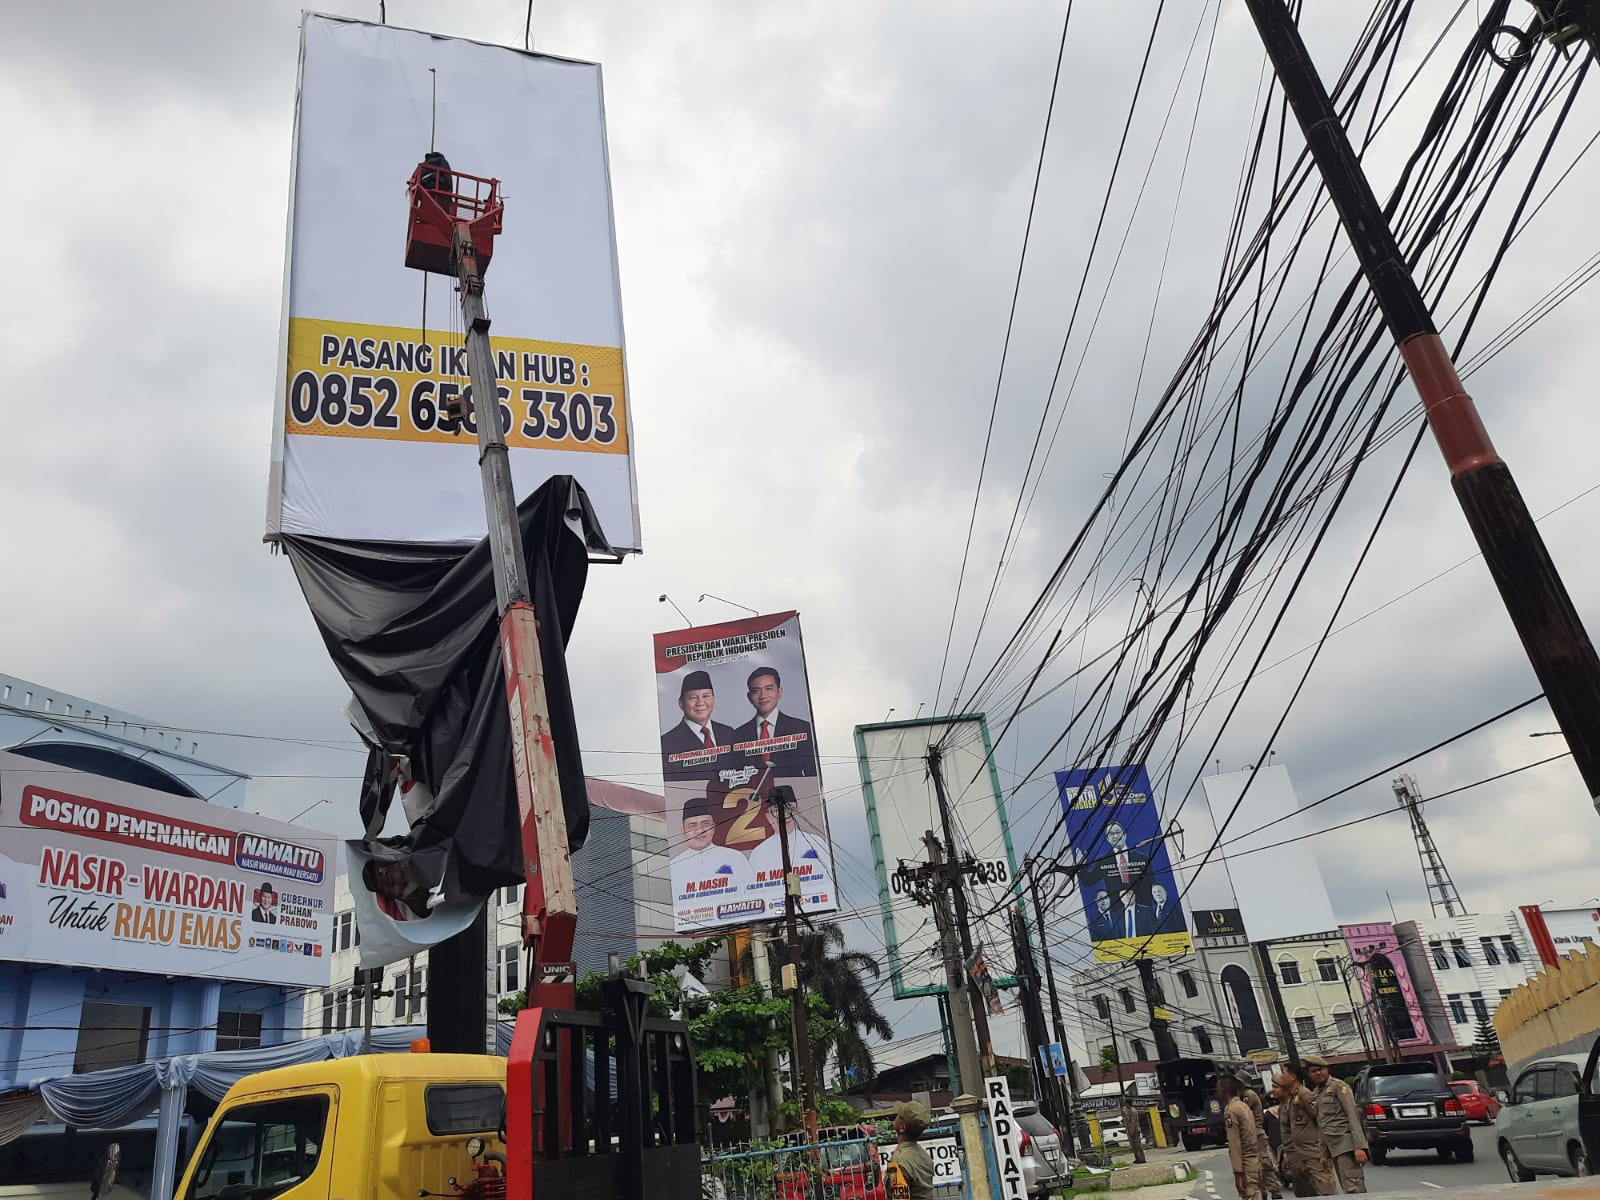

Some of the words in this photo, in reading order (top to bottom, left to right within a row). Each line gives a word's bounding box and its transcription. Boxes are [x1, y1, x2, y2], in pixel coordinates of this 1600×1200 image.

[321, 335, 433, 374] PASANG
[440, 345, 515, 380] IKN
[291, 371, 398, 428] 0852
[522, 389, 616, 443] 3303
[666, 643, 704, 657] PRESIDEN
[705, 640, 721, 650] DAN
[722, 636, 747, 648] WAKIL
[748, 629, 786, 644] PRESIDEN
[687, 648, 725, 662] REPUBLIK
[726, 641, 767, 655] INDONESIA
[30, 794, 100, 830] POSKO
[105, 811, 231, 857] PEMENANGAN
[722, 787, 766, 845] 2
[242, 837, 320, 869] NAWAITU
[39, 848, 125, 896] NASIR
[143, 866, 245, 914] WARDAN
[699, 876, 729, 891] NASIR
[756, 871, 767, 882] M.
[769, 864, 813, 880] WADAN
[280, 904, 313, 918] PILIHAN
[281, 892, 323, 909] GUBERNUR
[720, 900, 762, 914] NAWAITU
[48, 895, 114, 931] Untuk
[114, 903, 175, 943] RIAU
[179, 912, 242, 950] EMAS
[279, 915, 318, 930] PRABOWO
[543, 965, 570, 973] UNIC
[989, 1081, 1022, 1200] RADIAT
